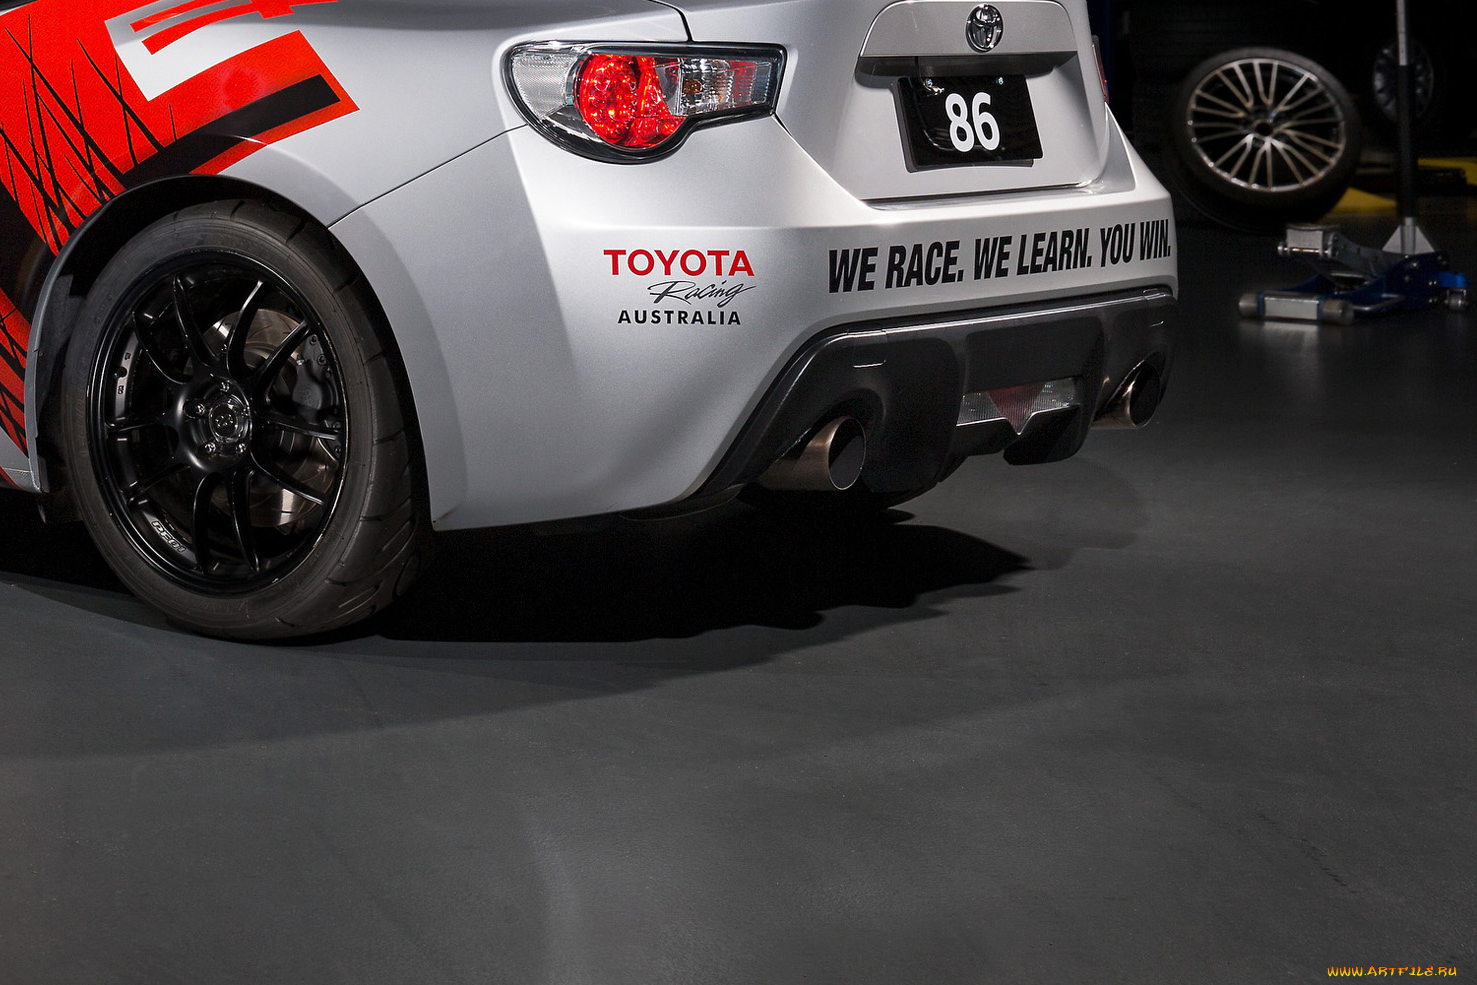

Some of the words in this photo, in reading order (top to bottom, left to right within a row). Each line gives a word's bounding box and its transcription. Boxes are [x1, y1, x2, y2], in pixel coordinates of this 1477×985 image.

[945, 92, 1001, 153] 86
[603, 249, 755, 277] TOYOTA
[828, 247, 878, 293] WE
[885, 240, 964, 289] RACE.
[973, 236, 1013, 281] WE
[1016, 228, 1093, 276] LEARN.
[1099, 223, 1136, 268] YOU
[1139, 219, 1171, 261] WIN.
[647, 280, 757, 308] Racing
[618, 310, 741, 325] AUSTRALIA
